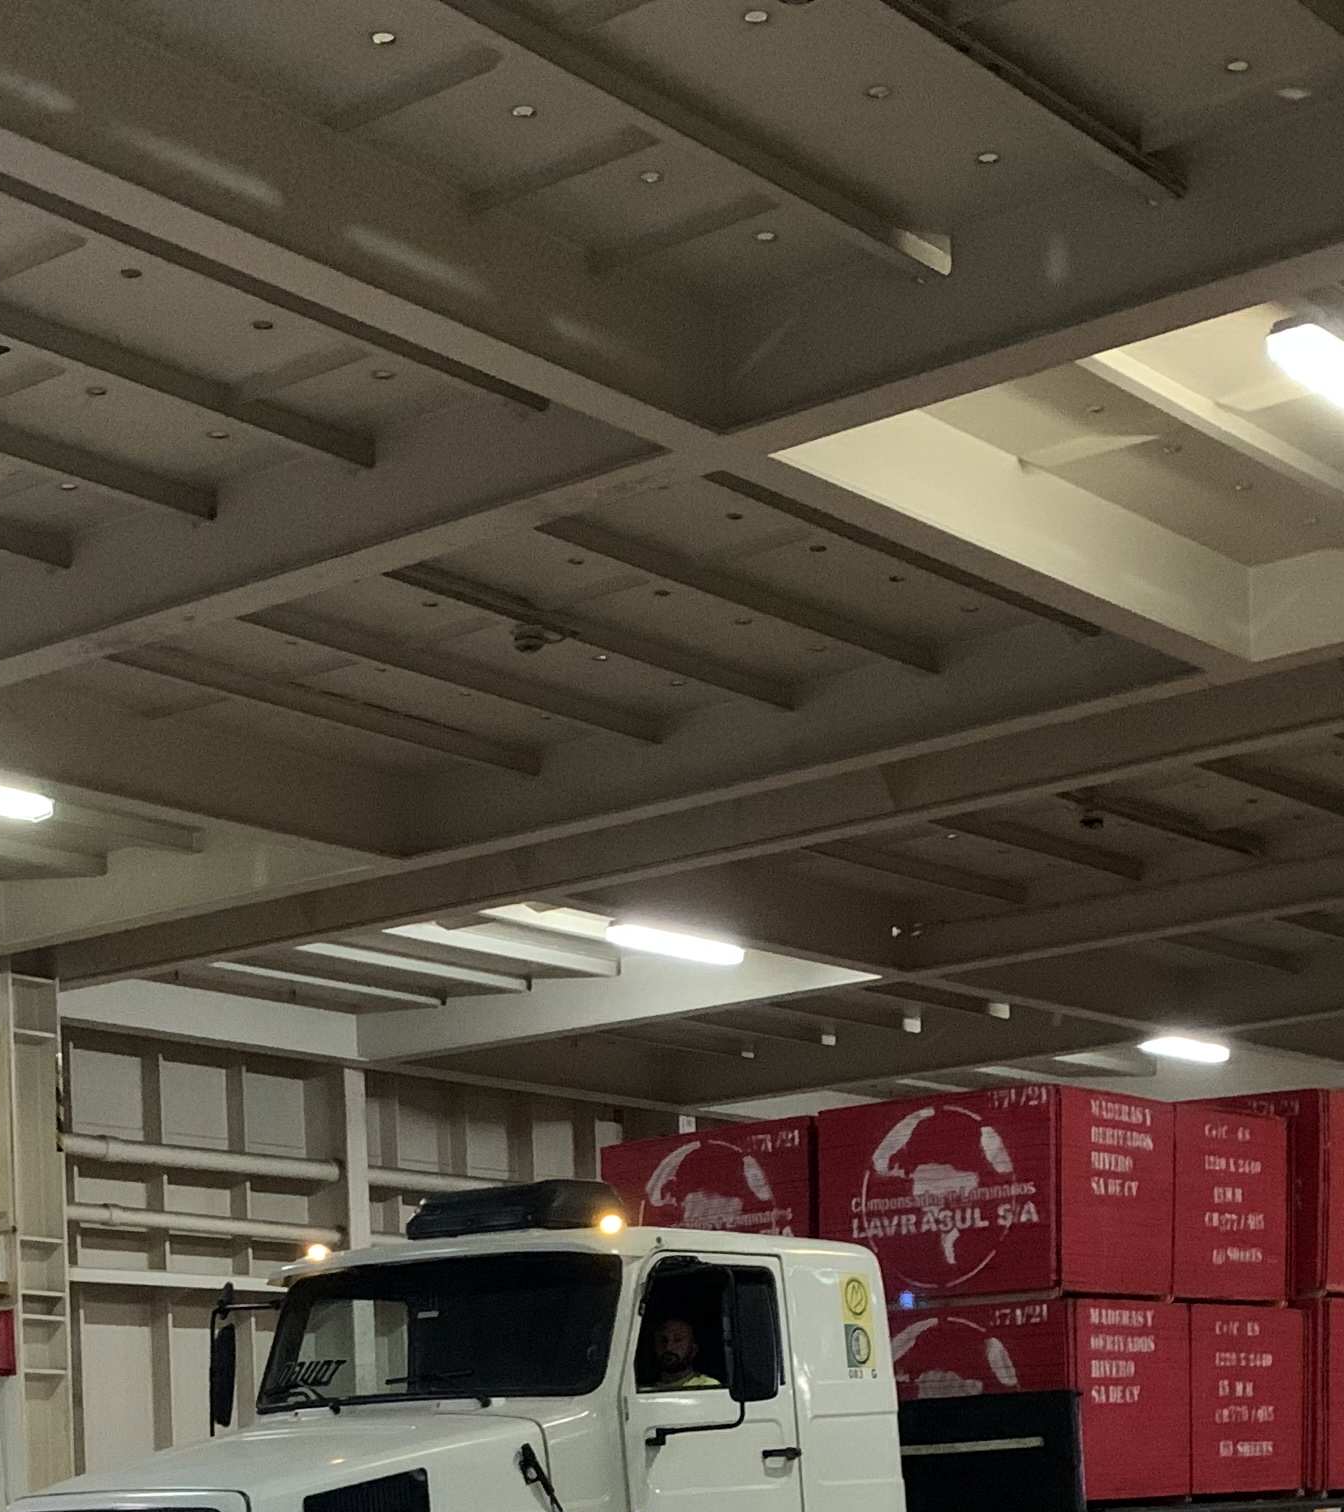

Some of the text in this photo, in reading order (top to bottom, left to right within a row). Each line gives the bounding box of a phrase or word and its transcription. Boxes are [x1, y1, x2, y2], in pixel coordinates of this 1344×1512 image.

[1090, 1098, 1143, 1124] MADERAS
[852, 1207, 989, 1238] LAVRASUL
[1090, 1307, 1154, 1327] MADERAS Y
[1090, 1334, 1155, 1353] DERIVADOS
[1091, 1359, 1135, 1378] RIVERO
